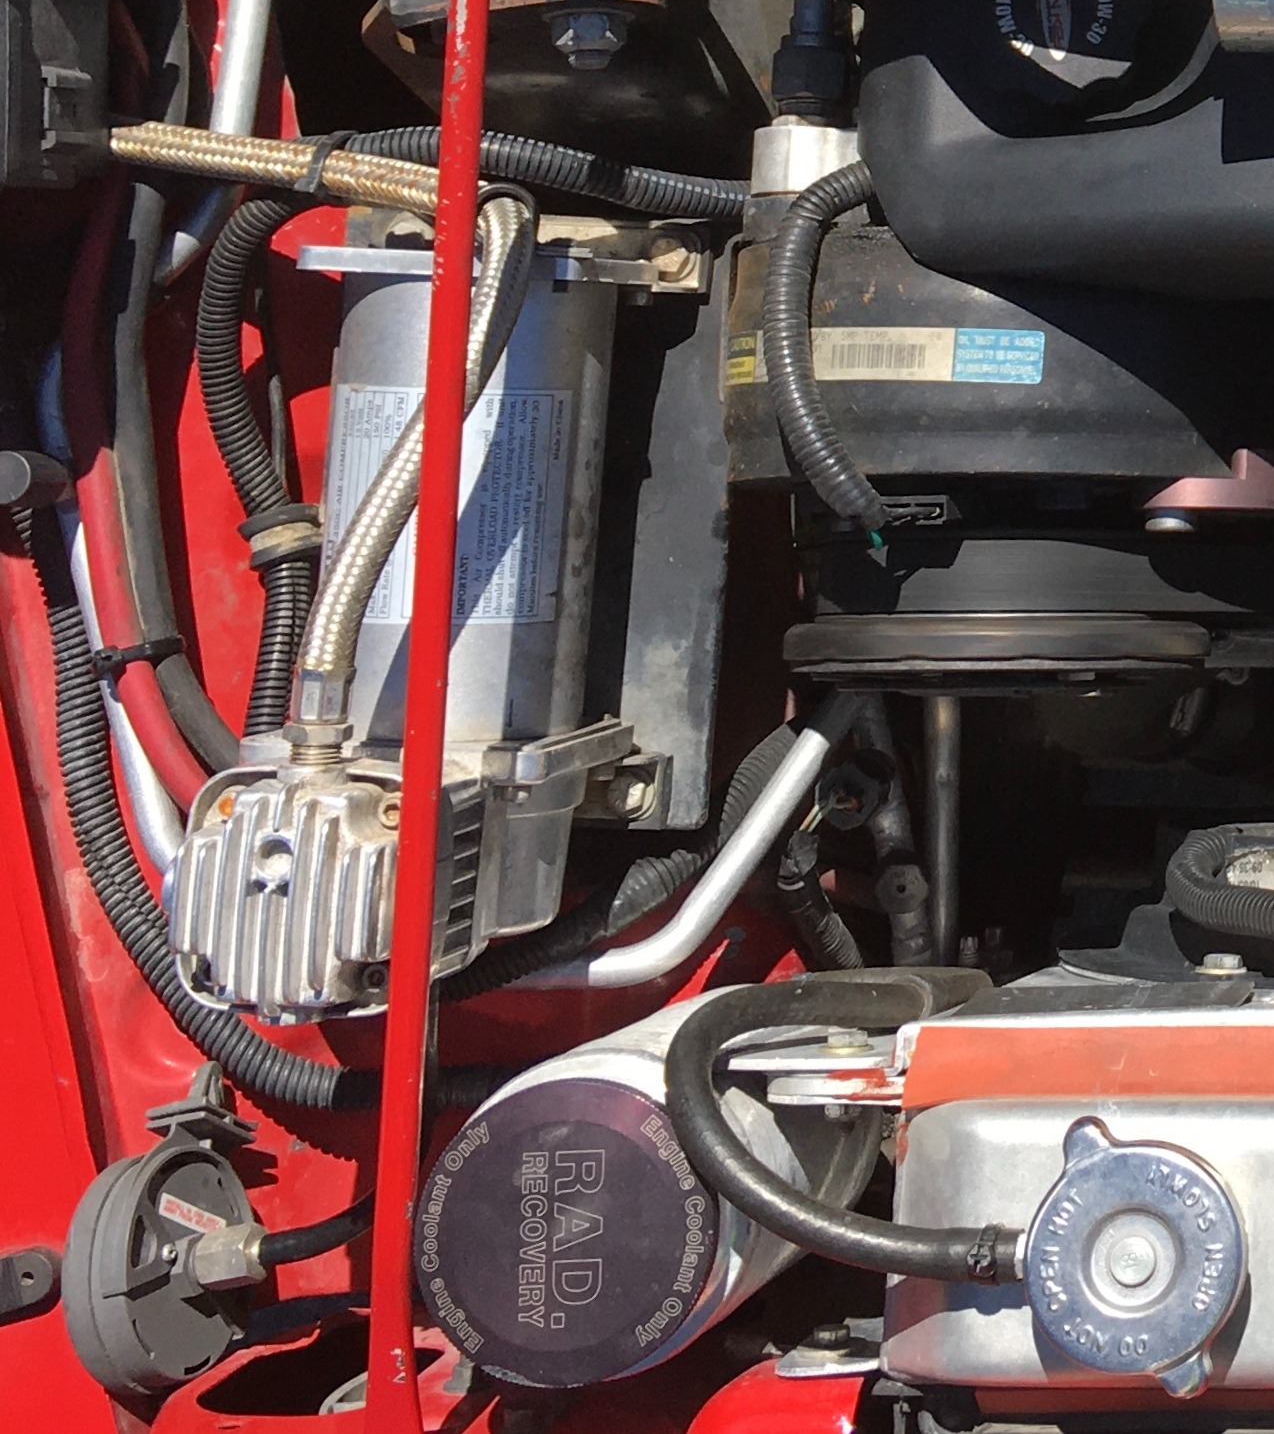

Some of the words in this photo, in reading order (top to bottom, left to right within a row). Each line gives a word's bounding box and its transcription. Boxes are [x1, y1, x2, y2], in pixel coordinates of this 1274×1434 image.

[444, 1121, 492, 1172] Only
[639, 1114, 697, 1191] Engine
[420, 1174, 452, 1273] Coolant
[517, 1151, 549, 1329] RECOVERY
[673, 1195, 706, 1294] Coolant
[428, 1277, 485, 1355] Engine
[634, 1296, 684, 1348] Only
